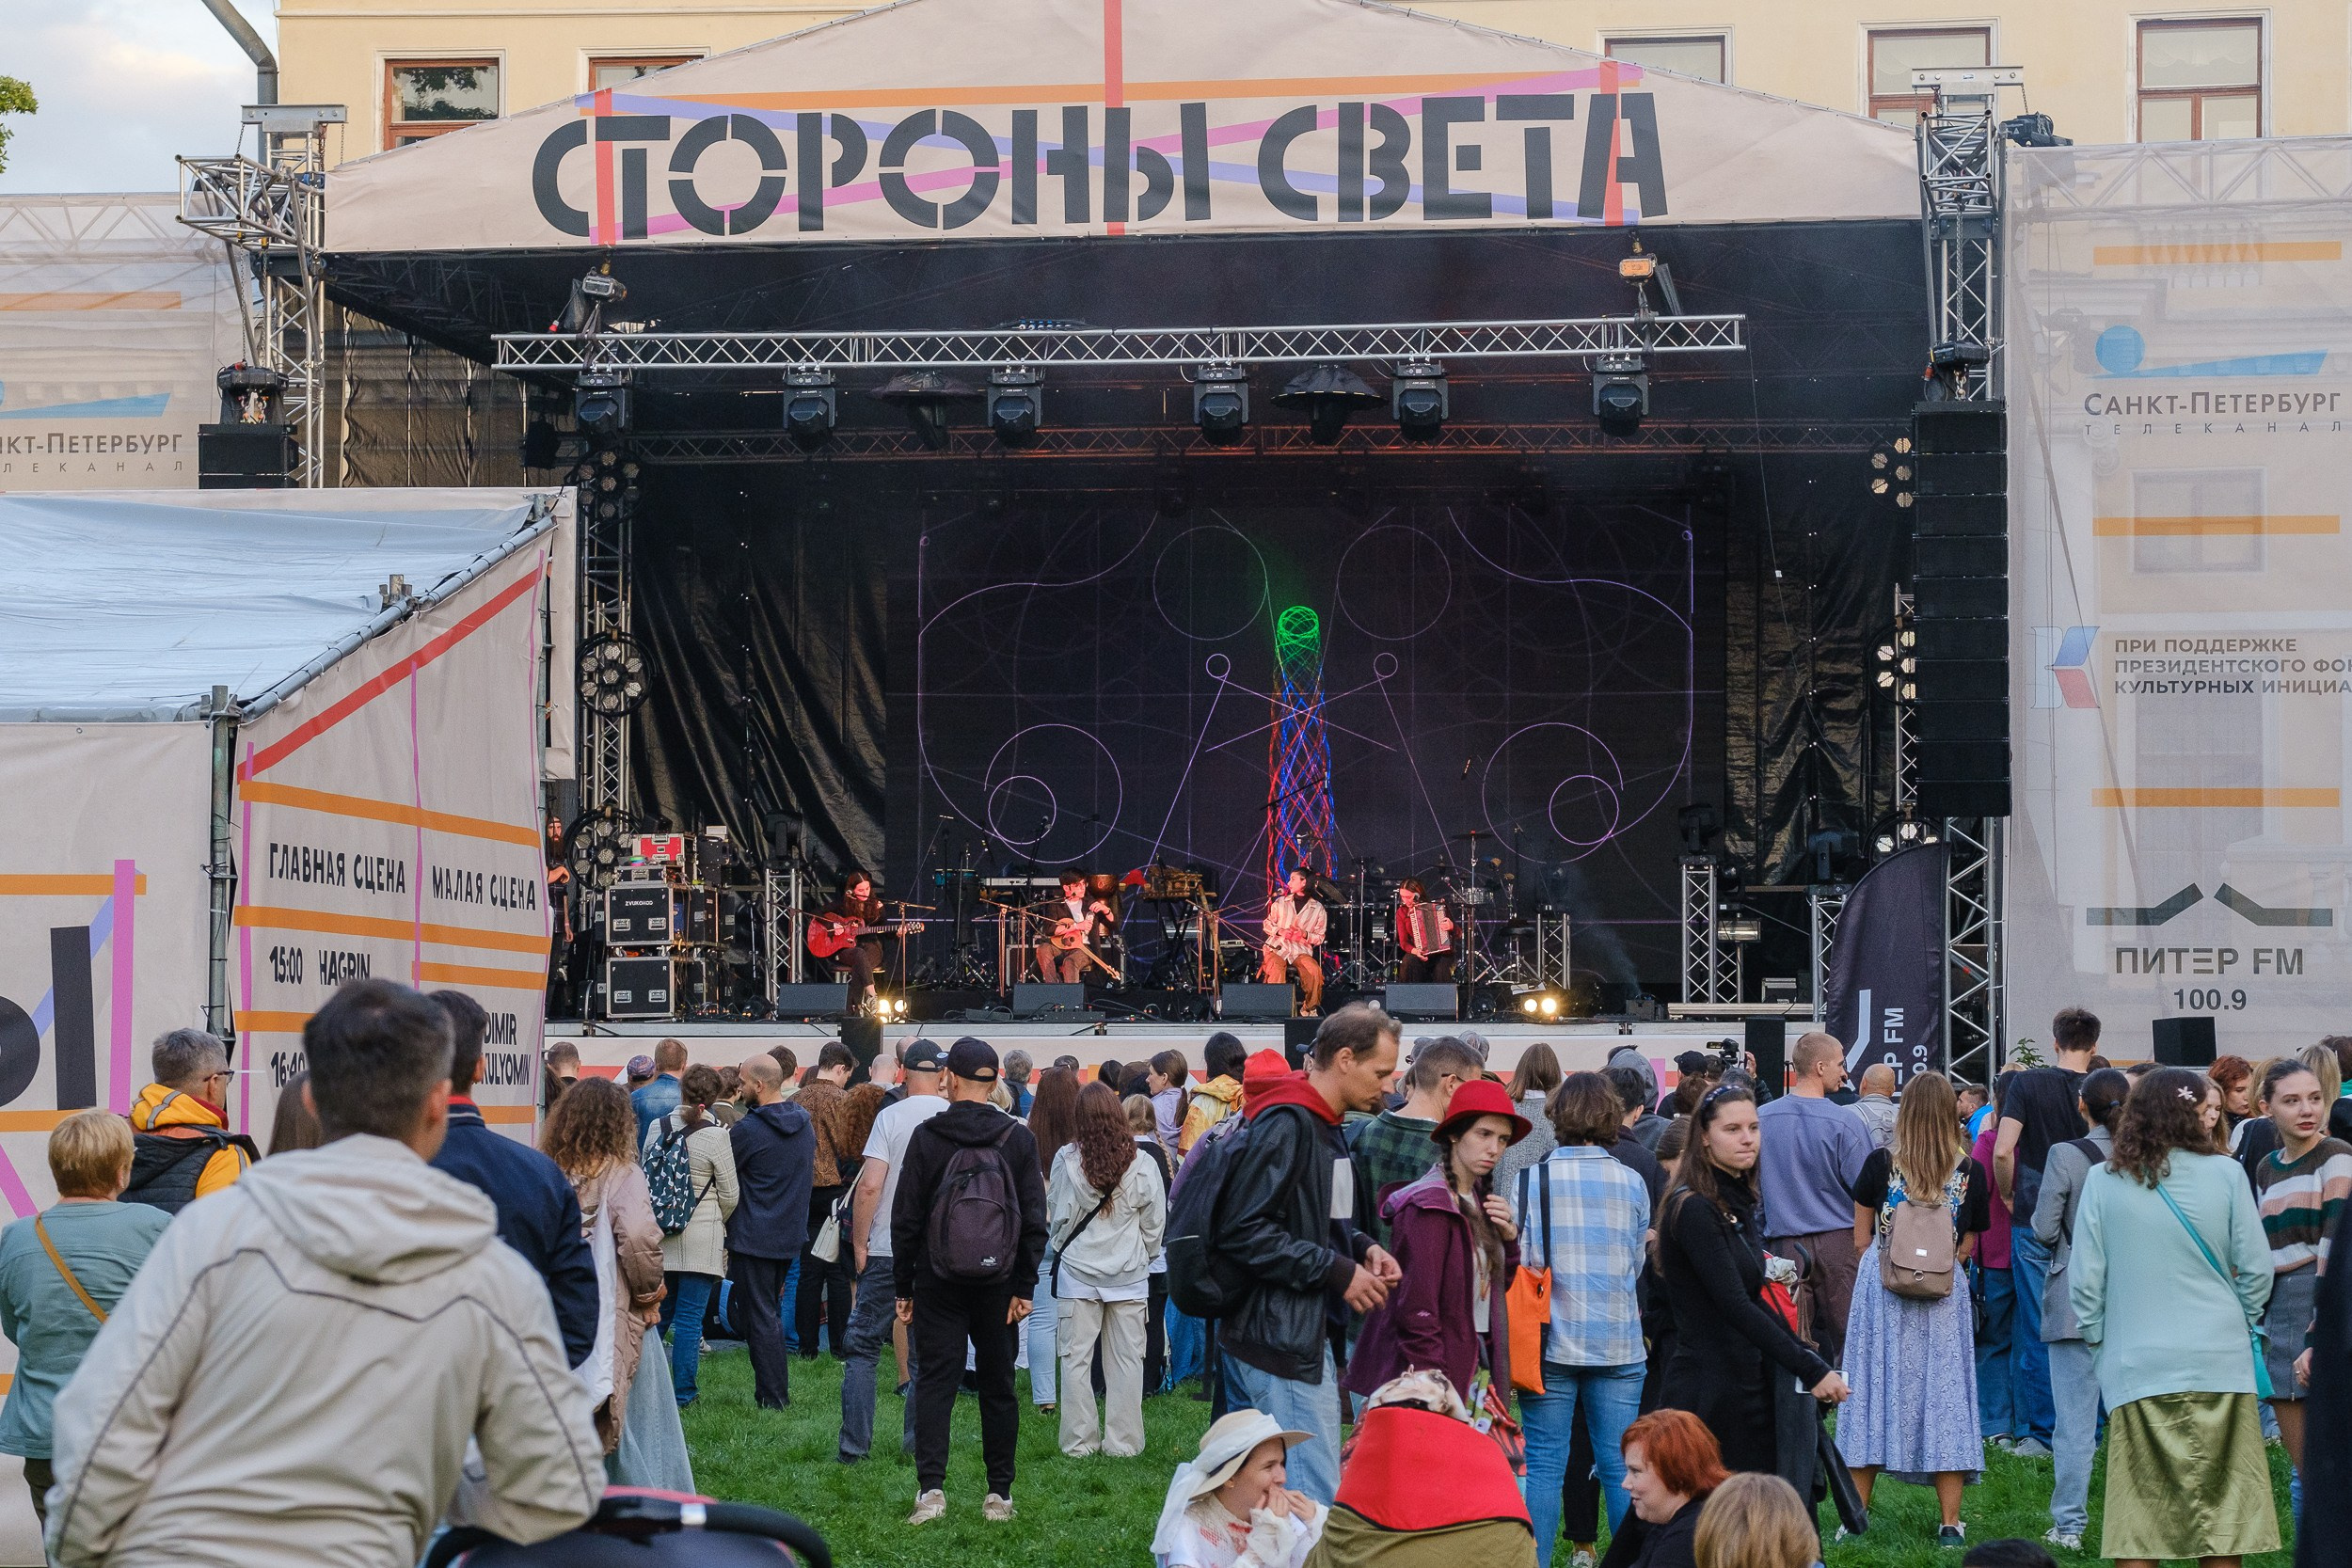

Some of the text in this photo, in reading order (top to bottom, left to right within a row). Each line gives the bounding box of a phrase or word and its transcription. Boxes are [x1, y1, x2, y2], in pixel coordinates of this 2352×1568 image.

[532, 92, 1669, 240] СТОРОНЫ СВЕТА
[2084, 391, 2341, 416] САНКТ-ПЕТЕРБУРГ
[0, 433, 183, 454] КТ-ПЕТЕРБУРГ
[2115, 639, 2296, 655] ПРИ ПОДДЕРЖКЕ
[2115, 659, 2306, 675] ПРЕЗИДЕНТСКОГО
[2115, 680, 2352, 696] КУЛЬТУРНЫХ ИНИЦИА
[269, 842, 405, 895] ГЛАВНАЯ СЦЕНА
[433, 865, 536, 911] МАЛАЯ СЦЕНА
[269, 945, 371, 986] 15:00 HAGRIN
[2116, 947, 2303, 974] ПИТЕР FM
[2173, 989, 2247, 1011] 100.9
[484, 1012, 516, 1046] DIMIR
